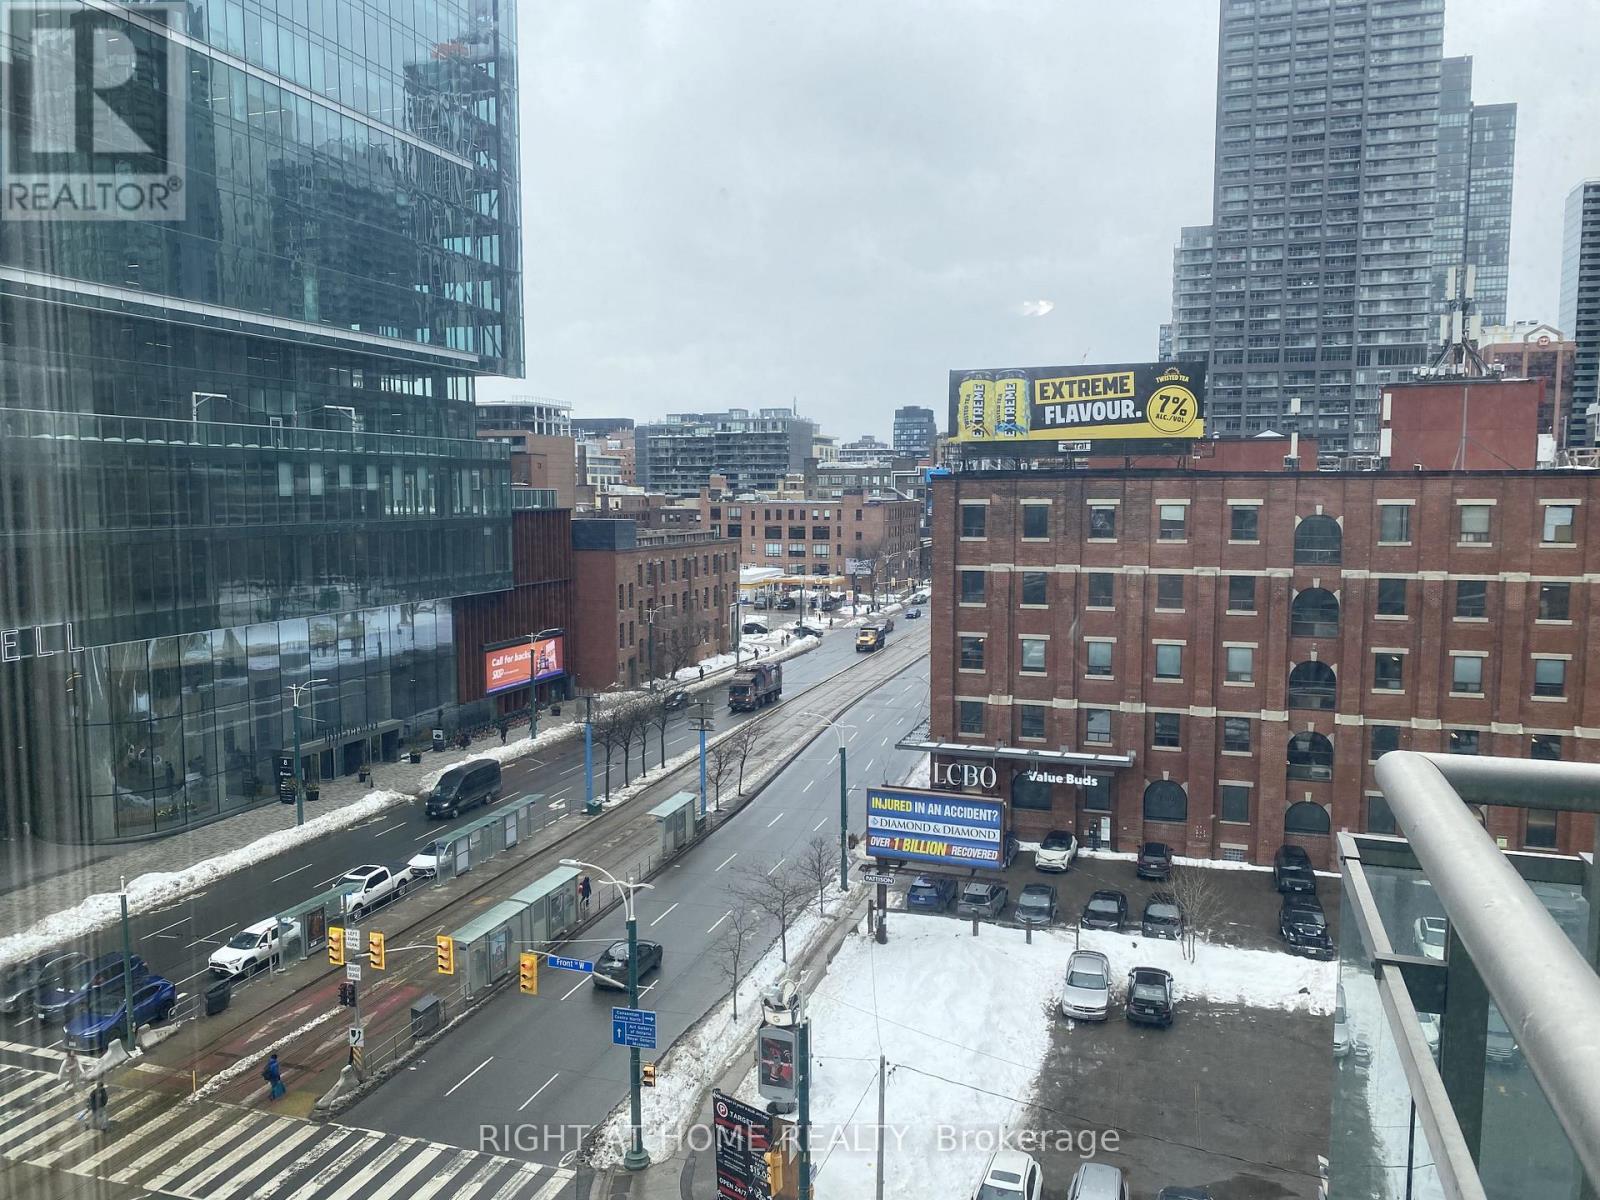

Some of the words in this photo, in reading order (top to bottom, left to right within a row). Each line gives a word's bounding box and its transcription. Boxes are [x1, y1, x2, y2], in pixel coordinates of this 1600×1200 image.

[1040, 375, 1130, 400] EXTREME
[973, 384, 985, 437] EXTREME
[1004, 383, 1016, 437] EXTREME
[1045, 400, 1142, 424] FLAVOUR.
[1159, 395, 1187, 416] 7%
[492, 656, 504, 667] Call
[934, 762, 997, 788] LCBO
[1029, 771, 1064, 784] Value
[1066, 774, 1098, 786] Buds
[872, 797, 912, 812] INJURED
[915, 802, 925, 814] IN
[928, 803, 942, 815] AN
[944, 805, 998, 822] ACCIDENT?
[880, 818, 931, 833] DIAMOND
[933, 825, 941, 833] &
[943, 825, 996, 840] DIAMOND
[871, 836, 890, 847] OVER
[894, 838, 899, 850] 1
[903, 839, 947, 856] BILLION
[951, 846, 998, 860] RECOVERED
[556, 958, 574, 968] Front
[579, 961, 585, 970] W
[719, 1177, 734, 1190] OPEN
